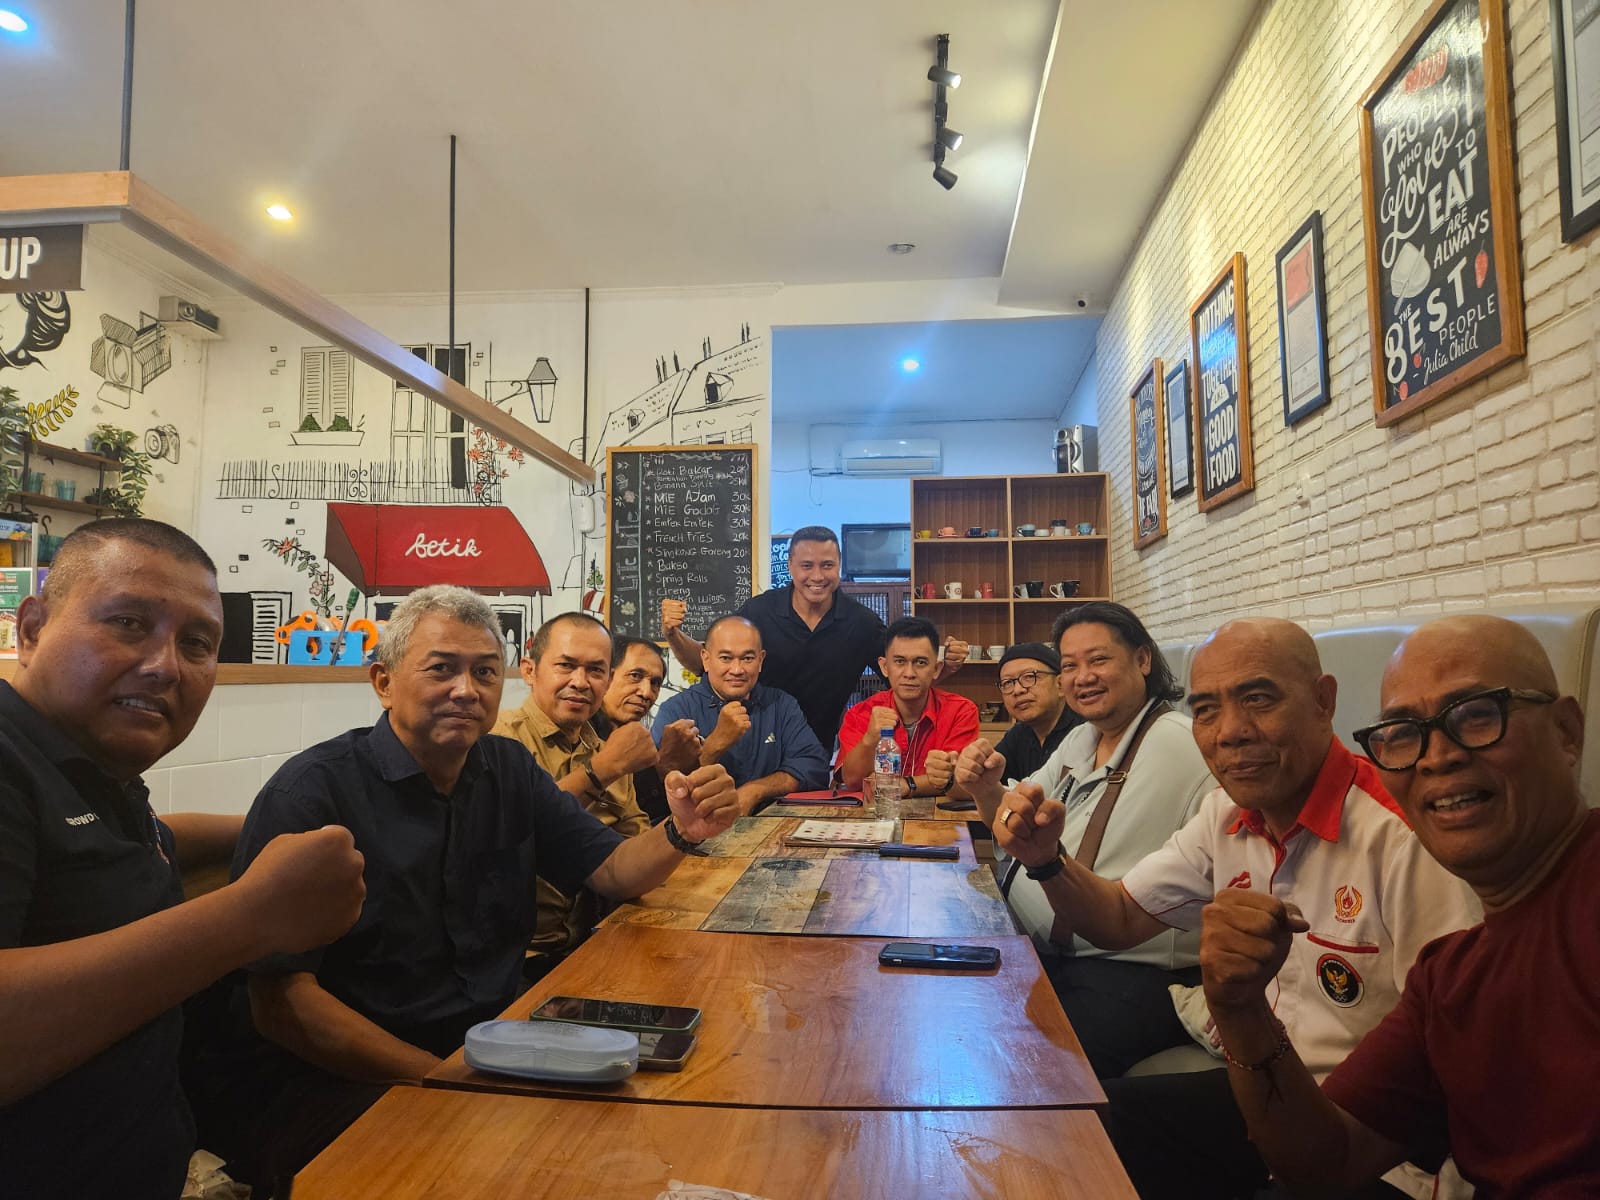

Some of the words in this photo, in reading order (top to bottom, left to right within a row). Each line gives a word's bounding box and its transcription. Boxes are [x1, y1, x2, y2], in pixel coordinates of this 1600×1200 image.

[1382, 74, 1452, 188] PEOPLE
[1455, 128, 1476, 158] TO
[1397, 142, 1422, 175] WHO
[1428, 147, 1477, 234] EAT
[1433, 209, 1490, 269] ALWAYS
[1446, 207, 1468, 238] ARE
[1199, 279, 1235, 350] NOTHING
[1399, 303, 1412, 325] THE
[1439, 293, 1495, 345] PEOPLE
[1424, 348, 1448, 385] Julia
[1450, 322, 1478, 362] Child
[1209, 404, 1234, 452] GOOD
[1209, 443, 1236, 490] FOOD
[405, 533, 482, 558] betik
